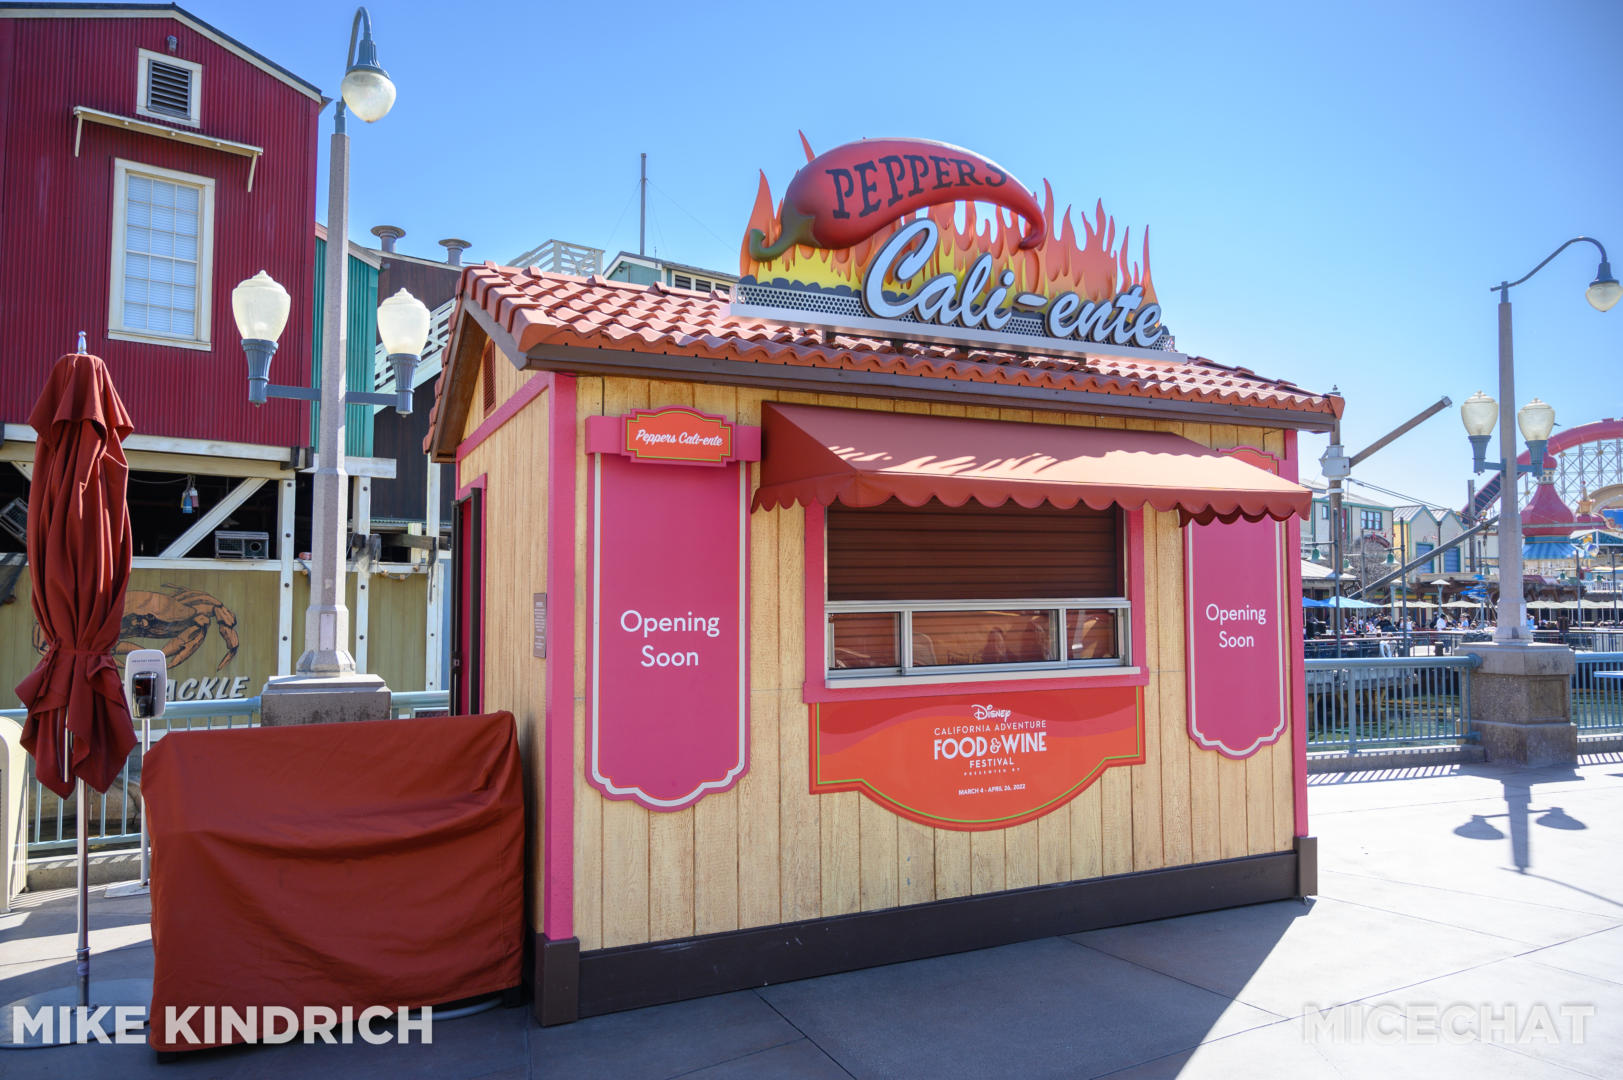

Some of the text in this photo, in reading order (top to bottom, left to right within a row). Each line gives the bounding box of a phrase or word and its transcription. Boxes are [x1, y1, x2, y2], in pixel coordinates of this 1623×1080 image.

[825, 153, 1008, 221] PEPPERS
[862, 217, 1163, 348] Cali-ente
[635, 428, 724, 447] Peppers Cali-ente
[620, 609, 721, 638] Opening
[1205, 603, 1267, 626] Opening
[1218, 630, 1255, 648] Soon
[640, 644, 699, 668] Soon
[165, 676, 249, 700] ACKLE
[934, 720, 1047, 736] CALIFORNIA ADVENTURE
[934, 731, 1047, 760] FOOD & WINE
[969, 757, 1015, 768] FESTIVAL
